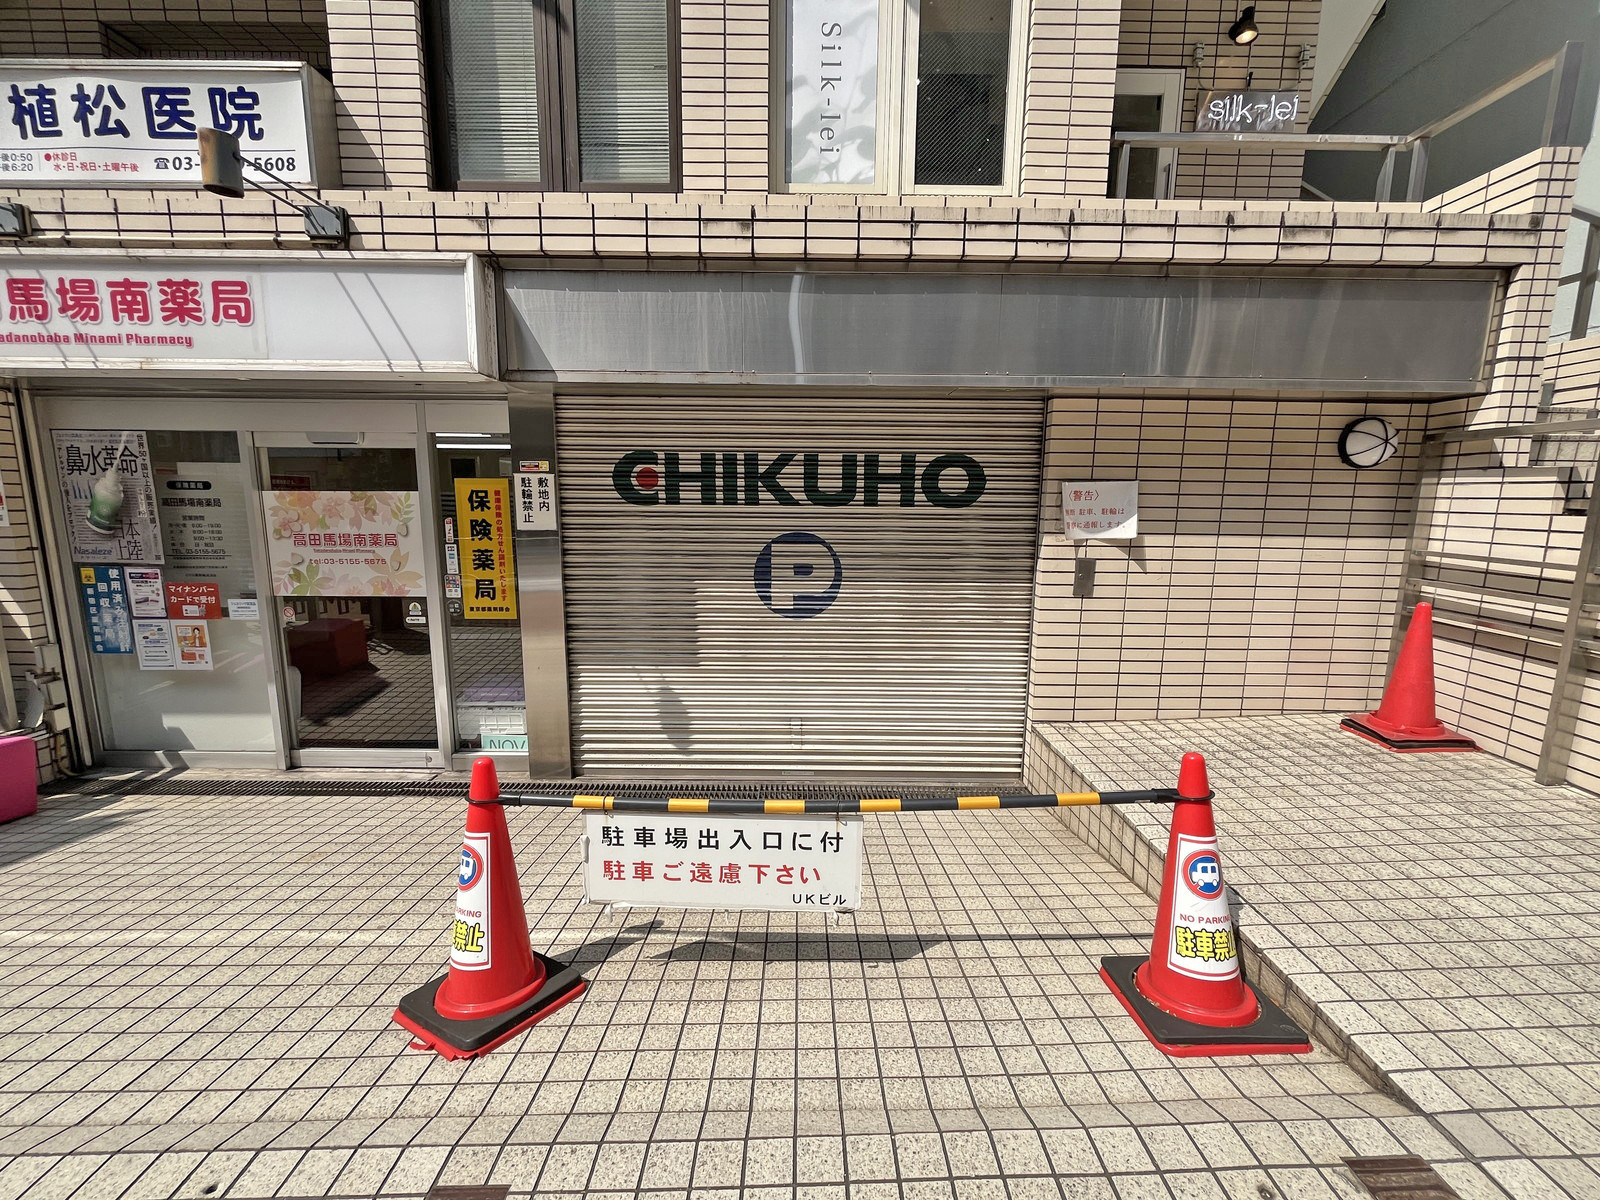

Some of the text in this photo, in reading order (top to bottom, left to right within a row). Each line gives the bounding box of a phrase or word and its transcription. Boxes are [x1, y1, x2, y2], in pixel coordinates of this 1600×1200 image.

[820, 22, 842, 154] Silk-lei
[8, 83, 264, 141] 植松医院
[1208, 94, 1299, 123] silk-lei
[0, 153, 33, 162] 後0:50
[0, 163, 34, 172] 後6:20
[74, 333, 122, 345] Minami
[126, 333, 193, 348] Pharmacy
[66, 444, 139, 477] 鼻水革命
[612, 450, 987, 508] CHIKUHO
[521, 477, 534, 524] 駐輪禁止
[537, 477, 550, 512] 敷地内
[117, 539, 144, 560] 上陸
[292, 533, 399, 547] 高田馬場南薬局
[468, 489, 497, 601] 保険薬局
[168, 585, 215, 593] マイナンバー
[170, 595, 216, 604] カードで受付
[602, 825, 844, 853] 駐車場出入口に付
[603, 860, 821, 885] 駐車ご遠慮下さい
[792, 893, 847, 906] UKビル
[1179, 913, 1231, 924] NO PARKIN
